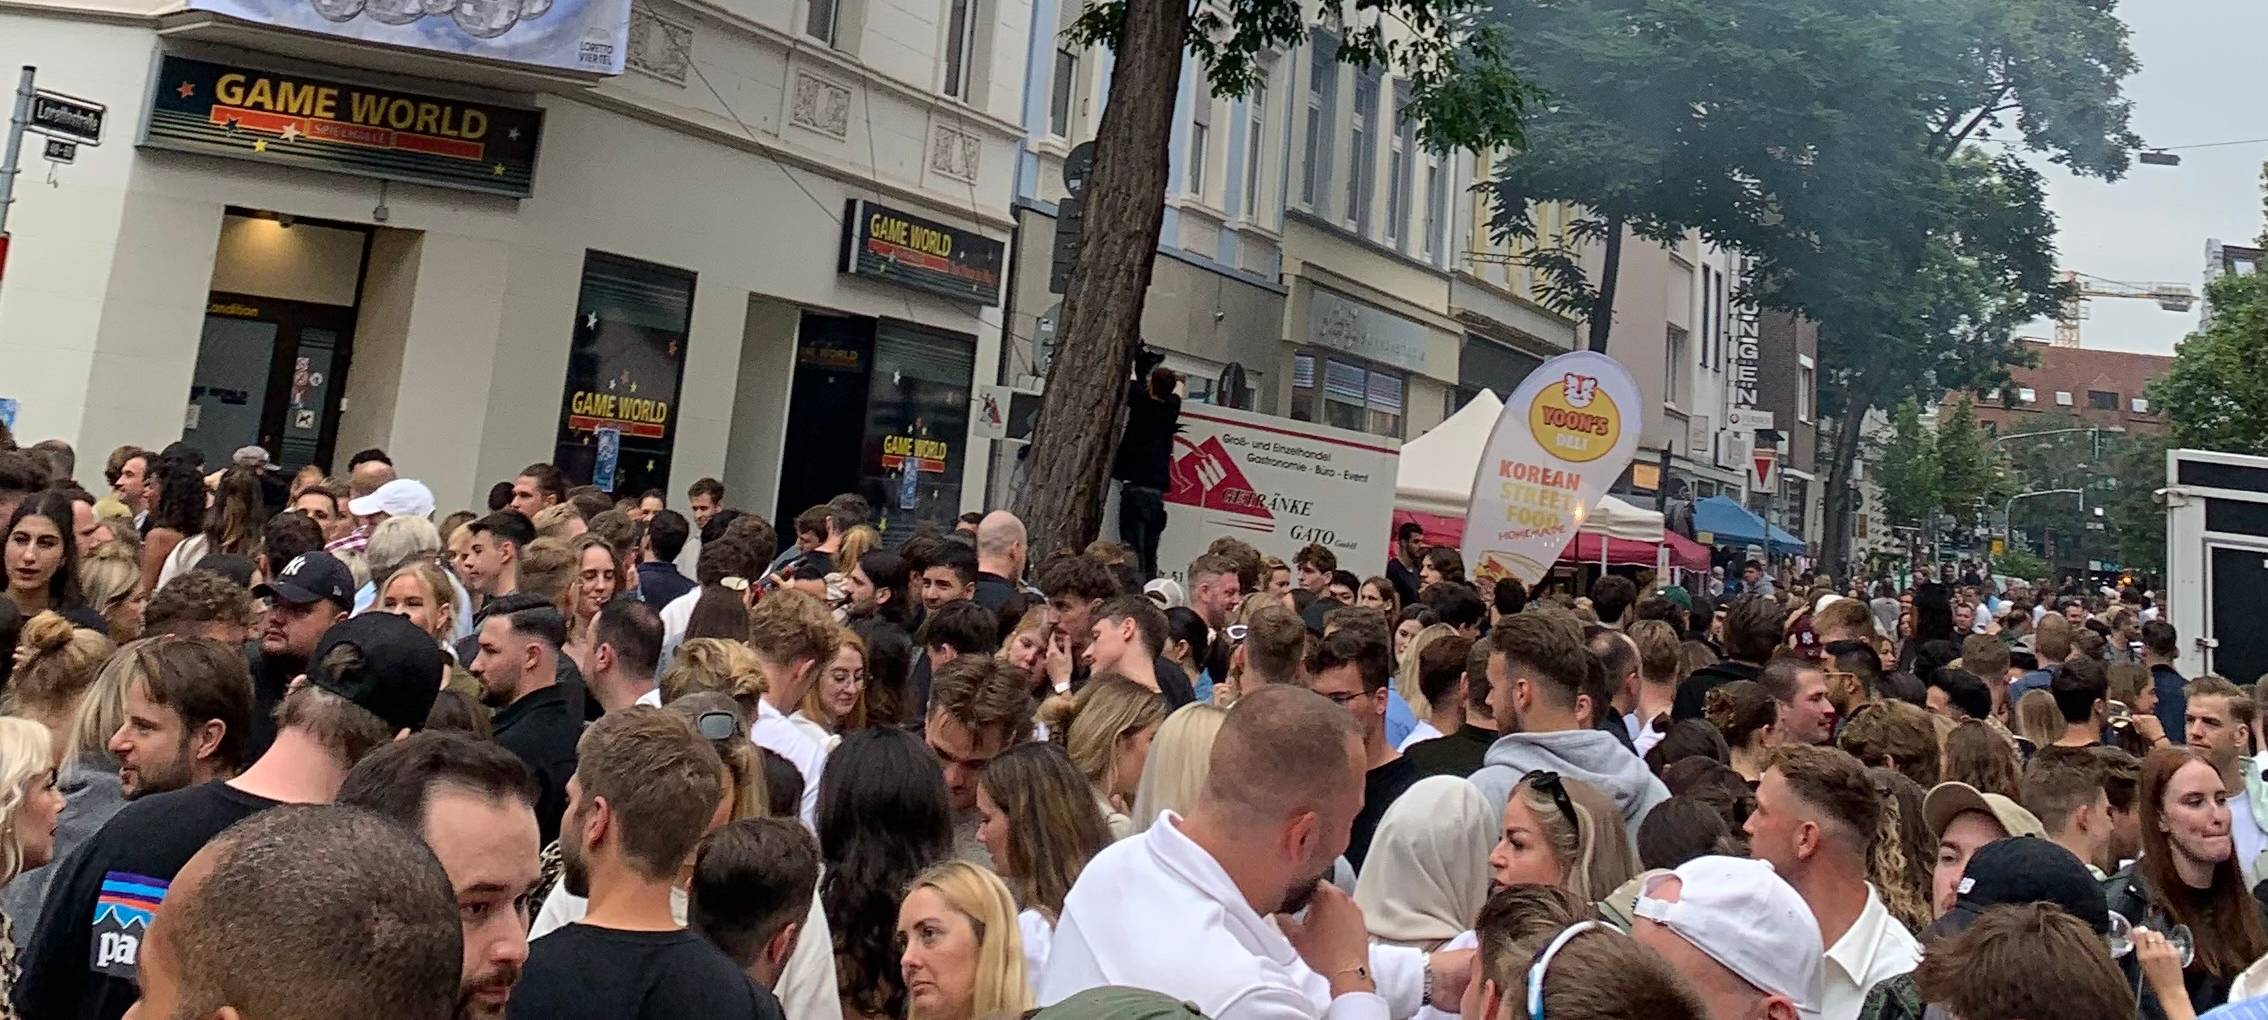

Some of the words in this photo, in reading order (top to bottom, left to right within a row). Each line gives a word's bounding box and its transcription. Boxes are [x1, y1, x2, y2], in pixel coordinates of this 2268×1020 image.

[215, 73, 339, 119] GAME
[350, 92, 488, 140] WORLD
[870, 213, 908, 246] GAME
[910, 224, 952, 257] WORLD
[572, 391, 616, 417] GAME
[619, 396, 668, 423] WORLD
[1541, 405, 1609, 436] YOON'S
[883, 434, 914, 456] GAME
[914, 438, 947, 460] WORLD
[1252, 440, 1270, 451] und
[1272, 442, 1331, 462] Einzelhandel
[1555, 432, 1590, 451] DELI
[1246, 453, 1307, 472] Gastronomie
[1315, 464, 1335, 477] Büro
[1343, 470, 1369, 482] Event
[1499, 459, 1581, 491] KOREAN
[1222, 488, 1314, 516] GETRÄNKE
[1501, 482, 1574, 512] STREET
[1506, 504, 1561, 530] FOOD
[1290, 524, 1335, 545] GATO
